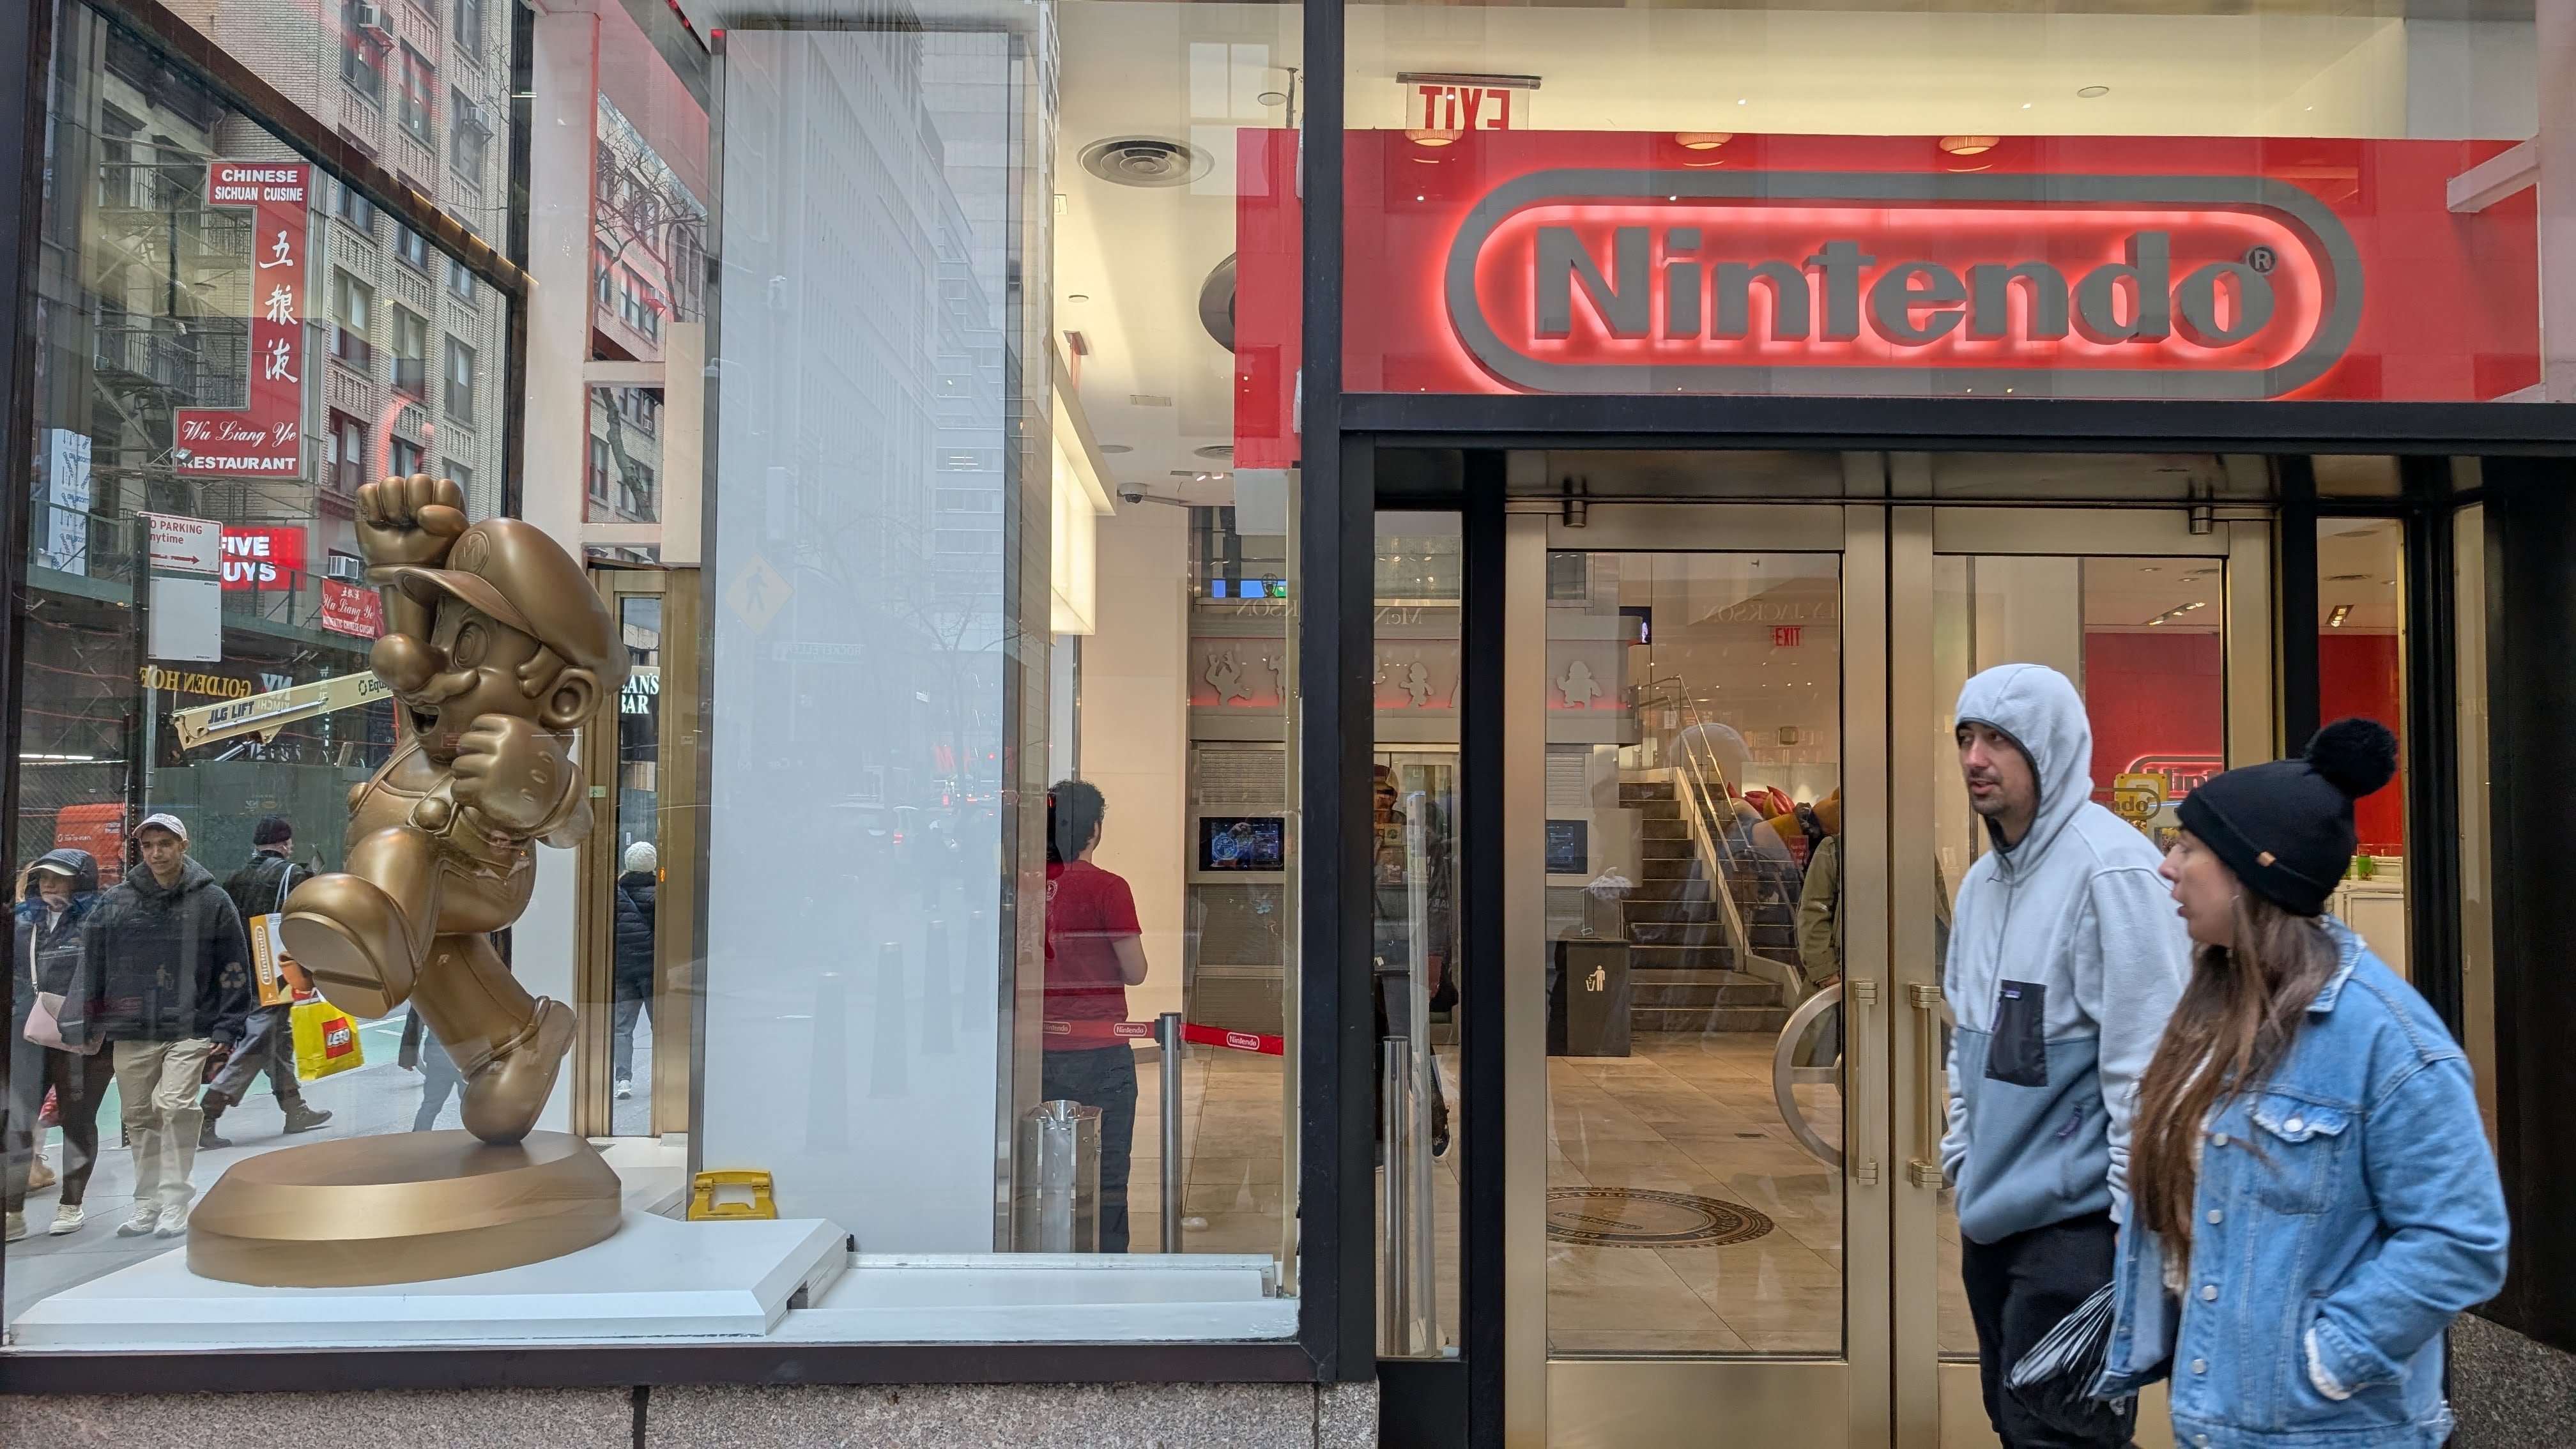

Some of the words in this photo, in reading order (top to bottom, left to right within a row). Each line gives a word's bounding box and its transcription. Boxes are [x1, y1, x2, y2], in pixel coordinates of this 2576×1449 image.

[221, 169, 298, 183] CHINESE
[215, 186, 258, 201] SICHUAN
[264, 187, 303, 201] CUISINE
[1533, 227, 2276, 348] Nintendo
[182, 420, 211, 441] Wu
[215, 420, 266, 447] Liang
[272, 422, 297, 447] Ye
[150, 520, 157, 528] O
[160, 522, 203, 534] PARKING
[150, 533, 184, 544] nytime
[222, 536, 270, 556] IVE
[223, 562, 277, 582] UYS
[1775, 627, 1801, 647] EXIT
[368, 679, 390, 693] Equ
[208, 709, 228, 724] JLG
[231, 700, 255, 719] LIFT
[326, 1029, 350, 1046] LEGO
[1117, 1025, 1144, 1034] Nintendo
[1229, 1035, 1257, 1047] Nintendo
